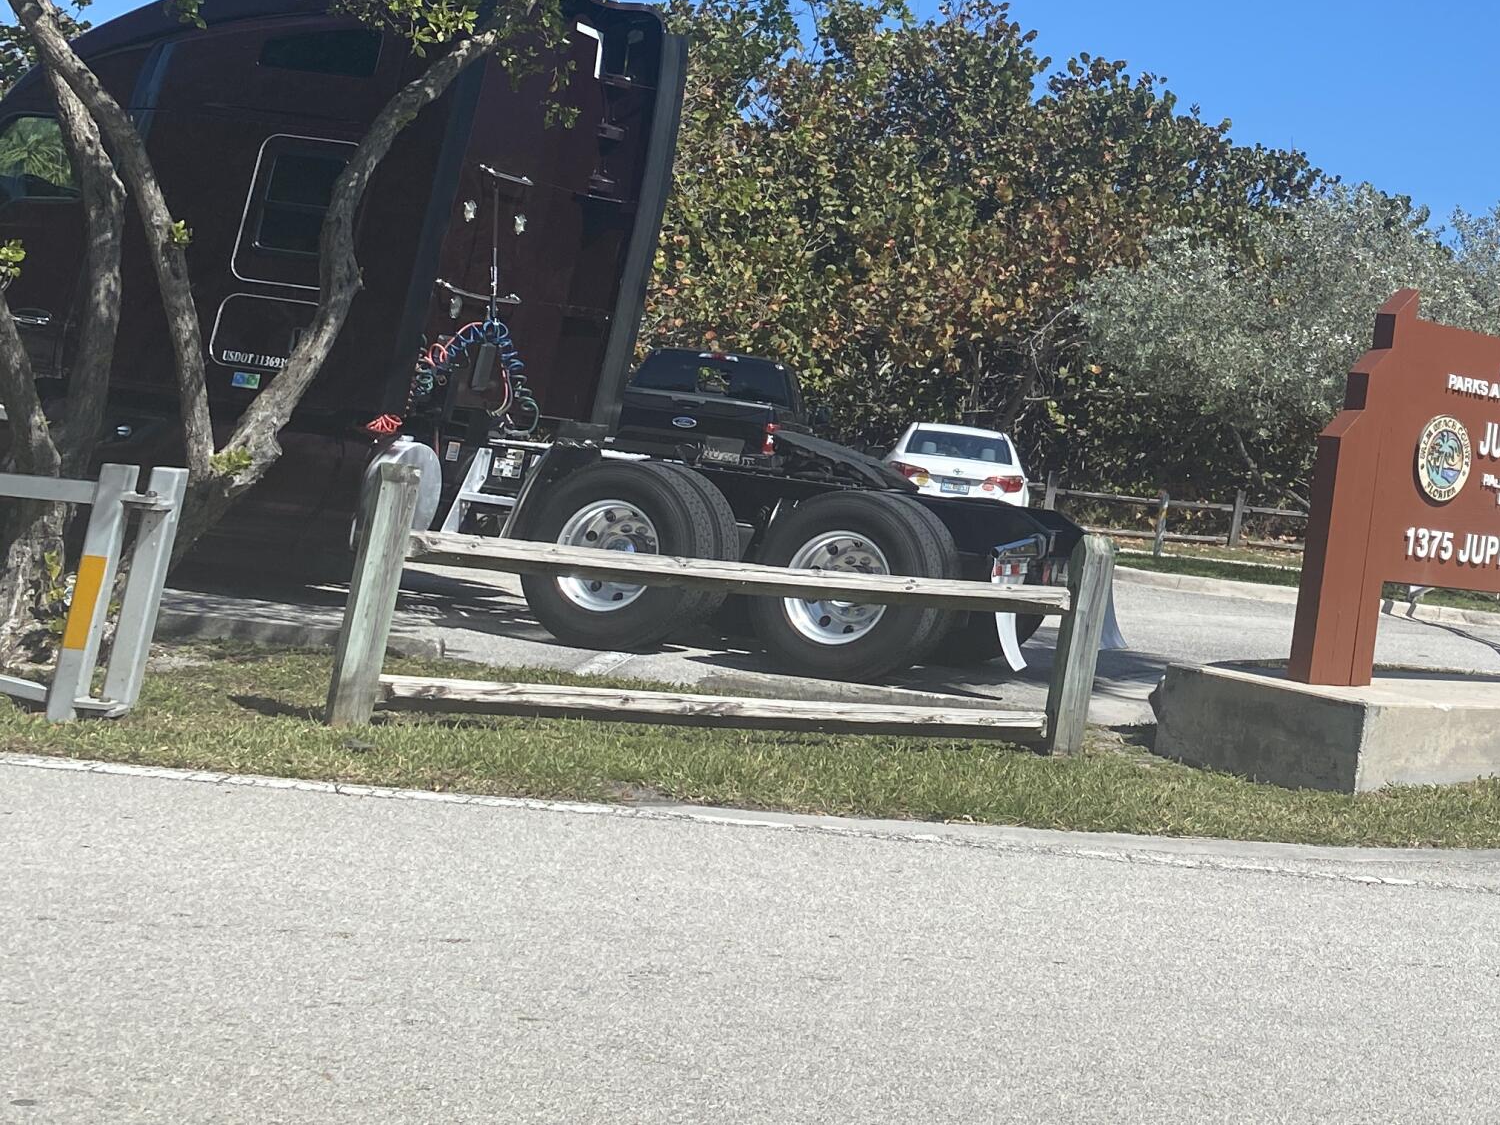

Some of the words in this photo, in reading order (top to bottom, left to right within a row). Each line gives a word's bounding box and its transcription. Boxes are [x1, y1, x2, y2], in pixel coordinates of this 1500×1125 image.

[222, 350, 254, 364] USDOT
[254, 355, 288, 368] 113693
[1447, 373, 1489, 396] PARKS
[1404, 526, 1454, 561] 1375
